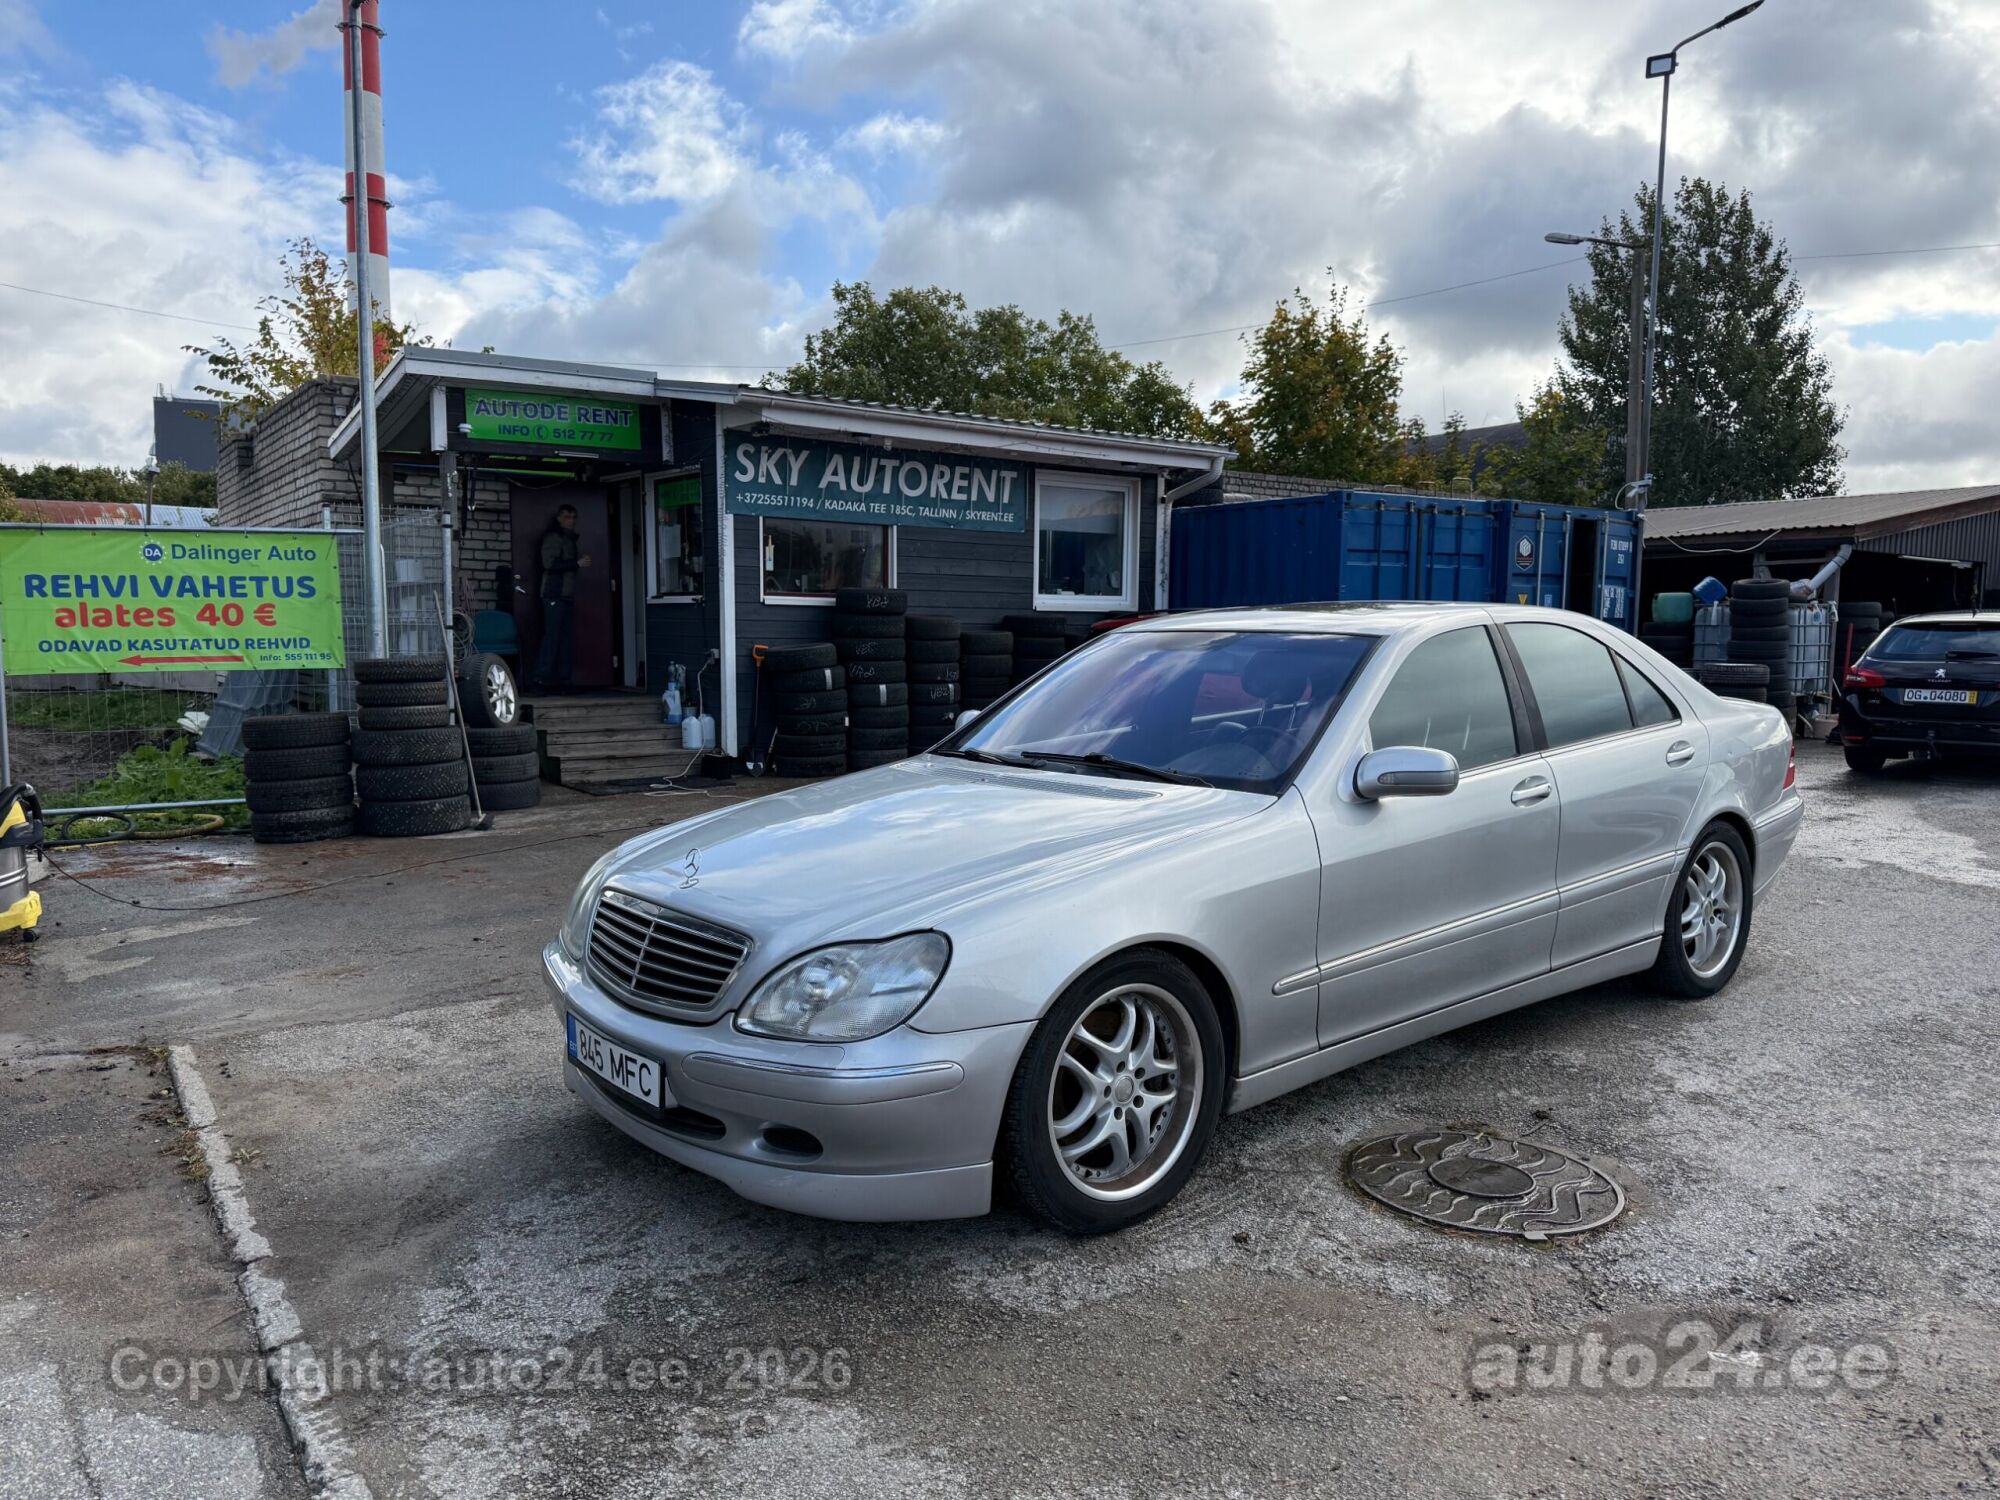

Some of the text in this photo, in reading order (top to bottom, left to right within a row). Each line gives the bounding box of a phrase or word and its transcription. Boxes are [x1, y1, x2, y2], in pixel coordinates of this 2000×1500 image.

[475, 399, 632, 428] AUTODE RENT
[498, 424, 530, 436] INFO
[553, 428, 576, 440] 512
[734, 443, 1018, 504] SKY AUTORENT
[736, 492, 814, 509] +37255511194
[824, 500, 867, 513] KADAKA
[870, 503, 887, 514] TEE
[890, 503, 916, 517] 185C,
[919, 506, 957, 519] TALLINN
[965, 510, 1014, 522] SKYRENT.EE
[144, 543, 317, 564] DA Dalinger Auto
[24, 574, 317, 598] REHVI VAHETUS
[55, 601, 277, 628] alates 40 €
[38, 637, 311, 653] ODAVAD KASUTATUD REHVID
[285, 653, 302, 661] 555
[319, 652, 332, 660] 95
[580, 1029, 652, 1097] 845 MFC
